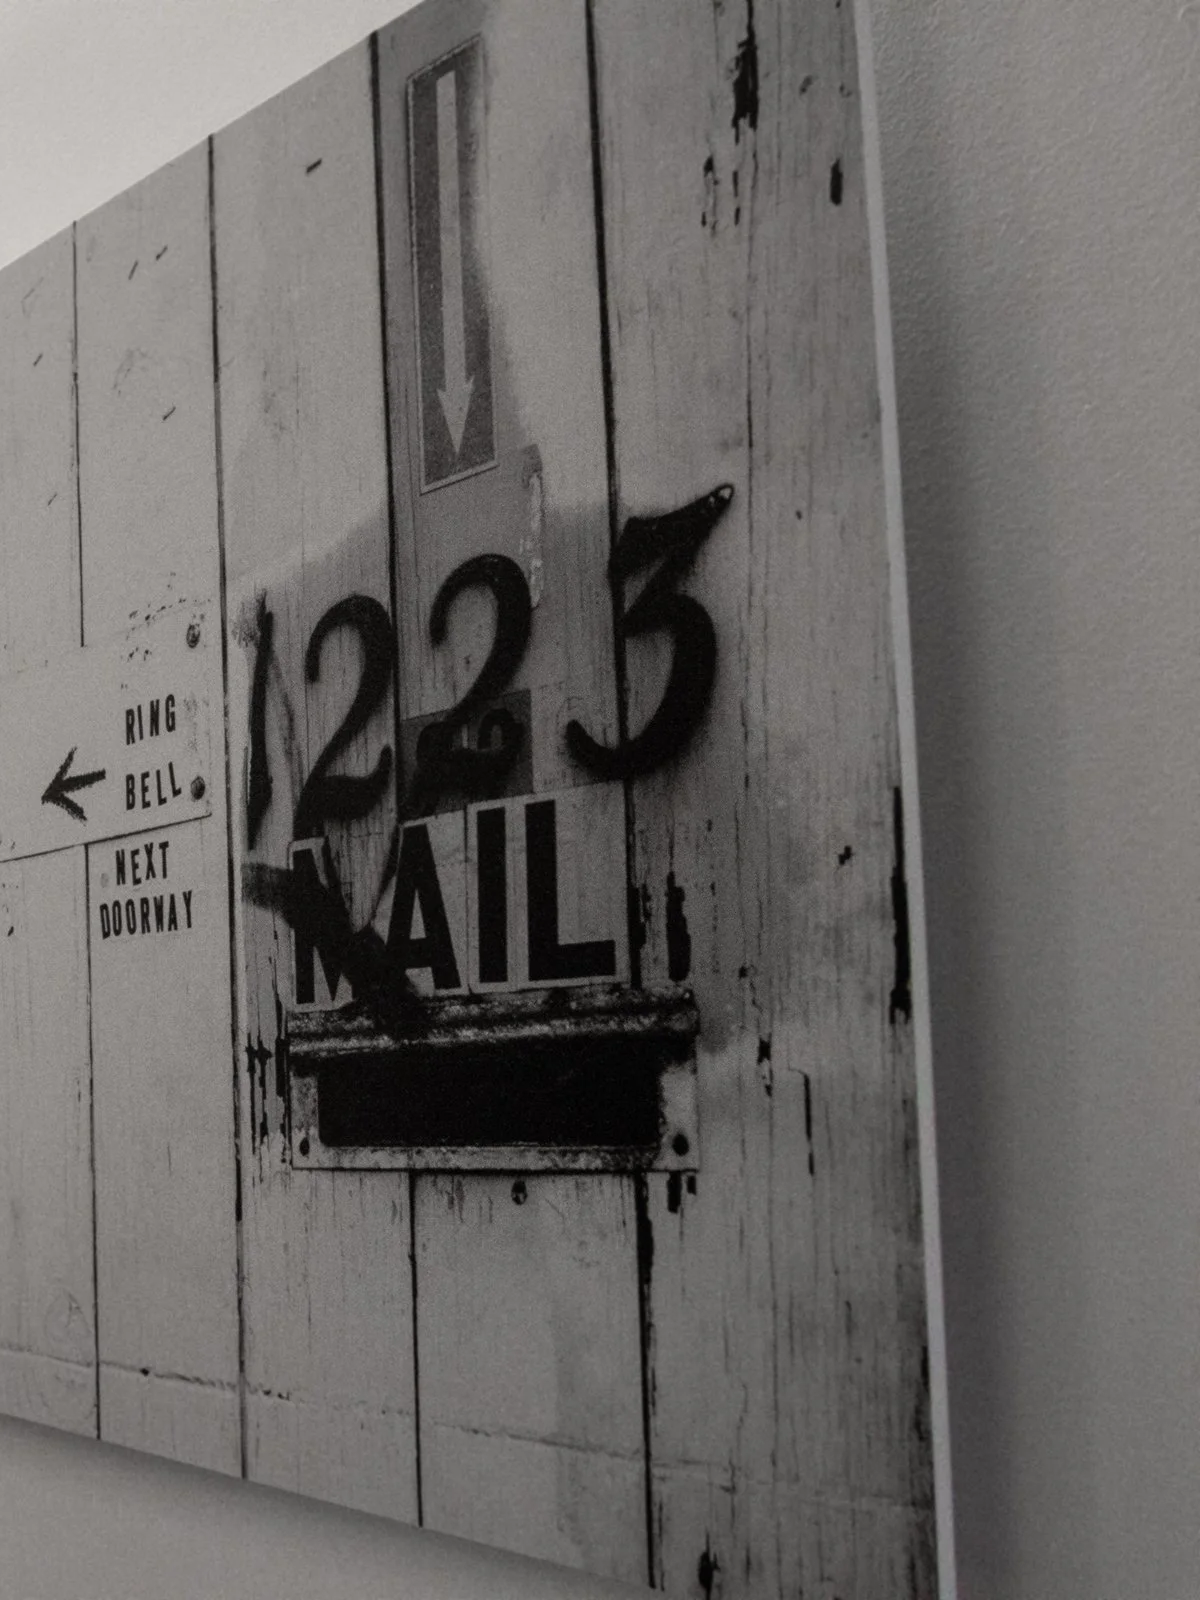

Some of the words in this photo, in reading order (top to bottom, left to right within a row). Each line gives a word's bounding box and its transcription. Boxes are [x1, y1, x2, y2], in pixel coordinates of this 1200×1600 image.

[246, 483, 734, 850] 1223
[126, 694, 176, 745] RING
[126, 762, 182, 811] BELL
[115, 841, 170, 886] NEXT
[100, 890, 193, 939] DOORWAY
[293, 800, 616, 1004] MAIL
